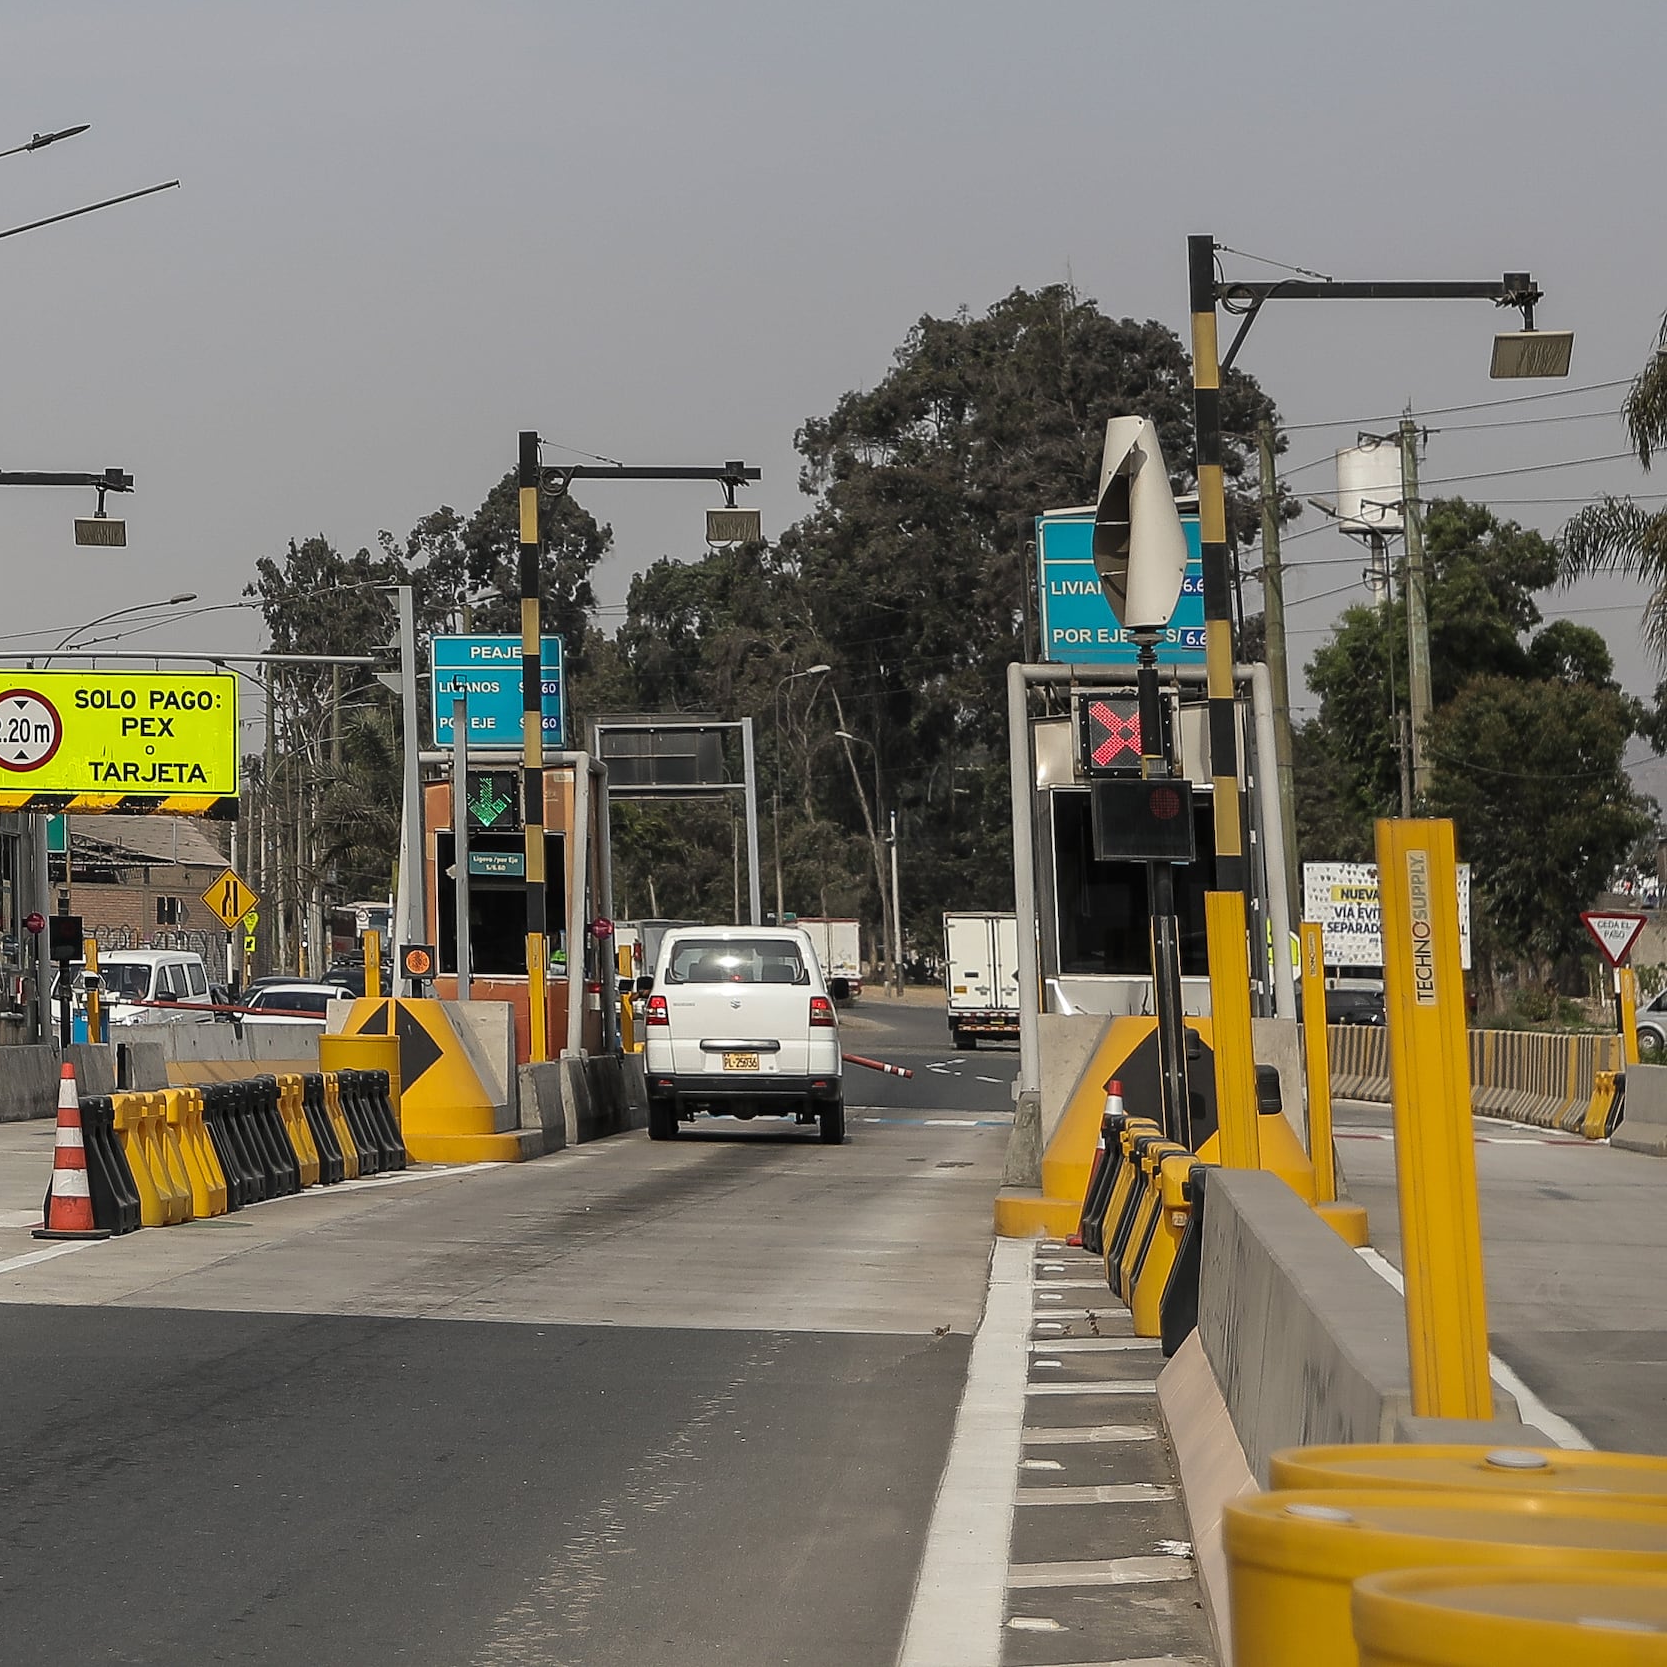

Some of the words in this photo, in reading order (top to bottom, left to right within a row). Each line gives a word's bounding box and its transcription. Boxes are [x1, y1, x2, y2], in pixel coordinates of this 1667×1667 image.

[1053, 628, 1092, 643] POR
[1097, 628, 1129, 643] EJE
[470, 646, 523, 659] PEAJE
[75, 689, 137, 709] SOLO
[149, 690, 222, 710] PAGO:
[121, 717, 174, 738] PEX
[470, 717, 497, 729] EJE
[88, 761, 208, 784] TARJETA
[1327, 921, 1382, 934] SEPARAD
